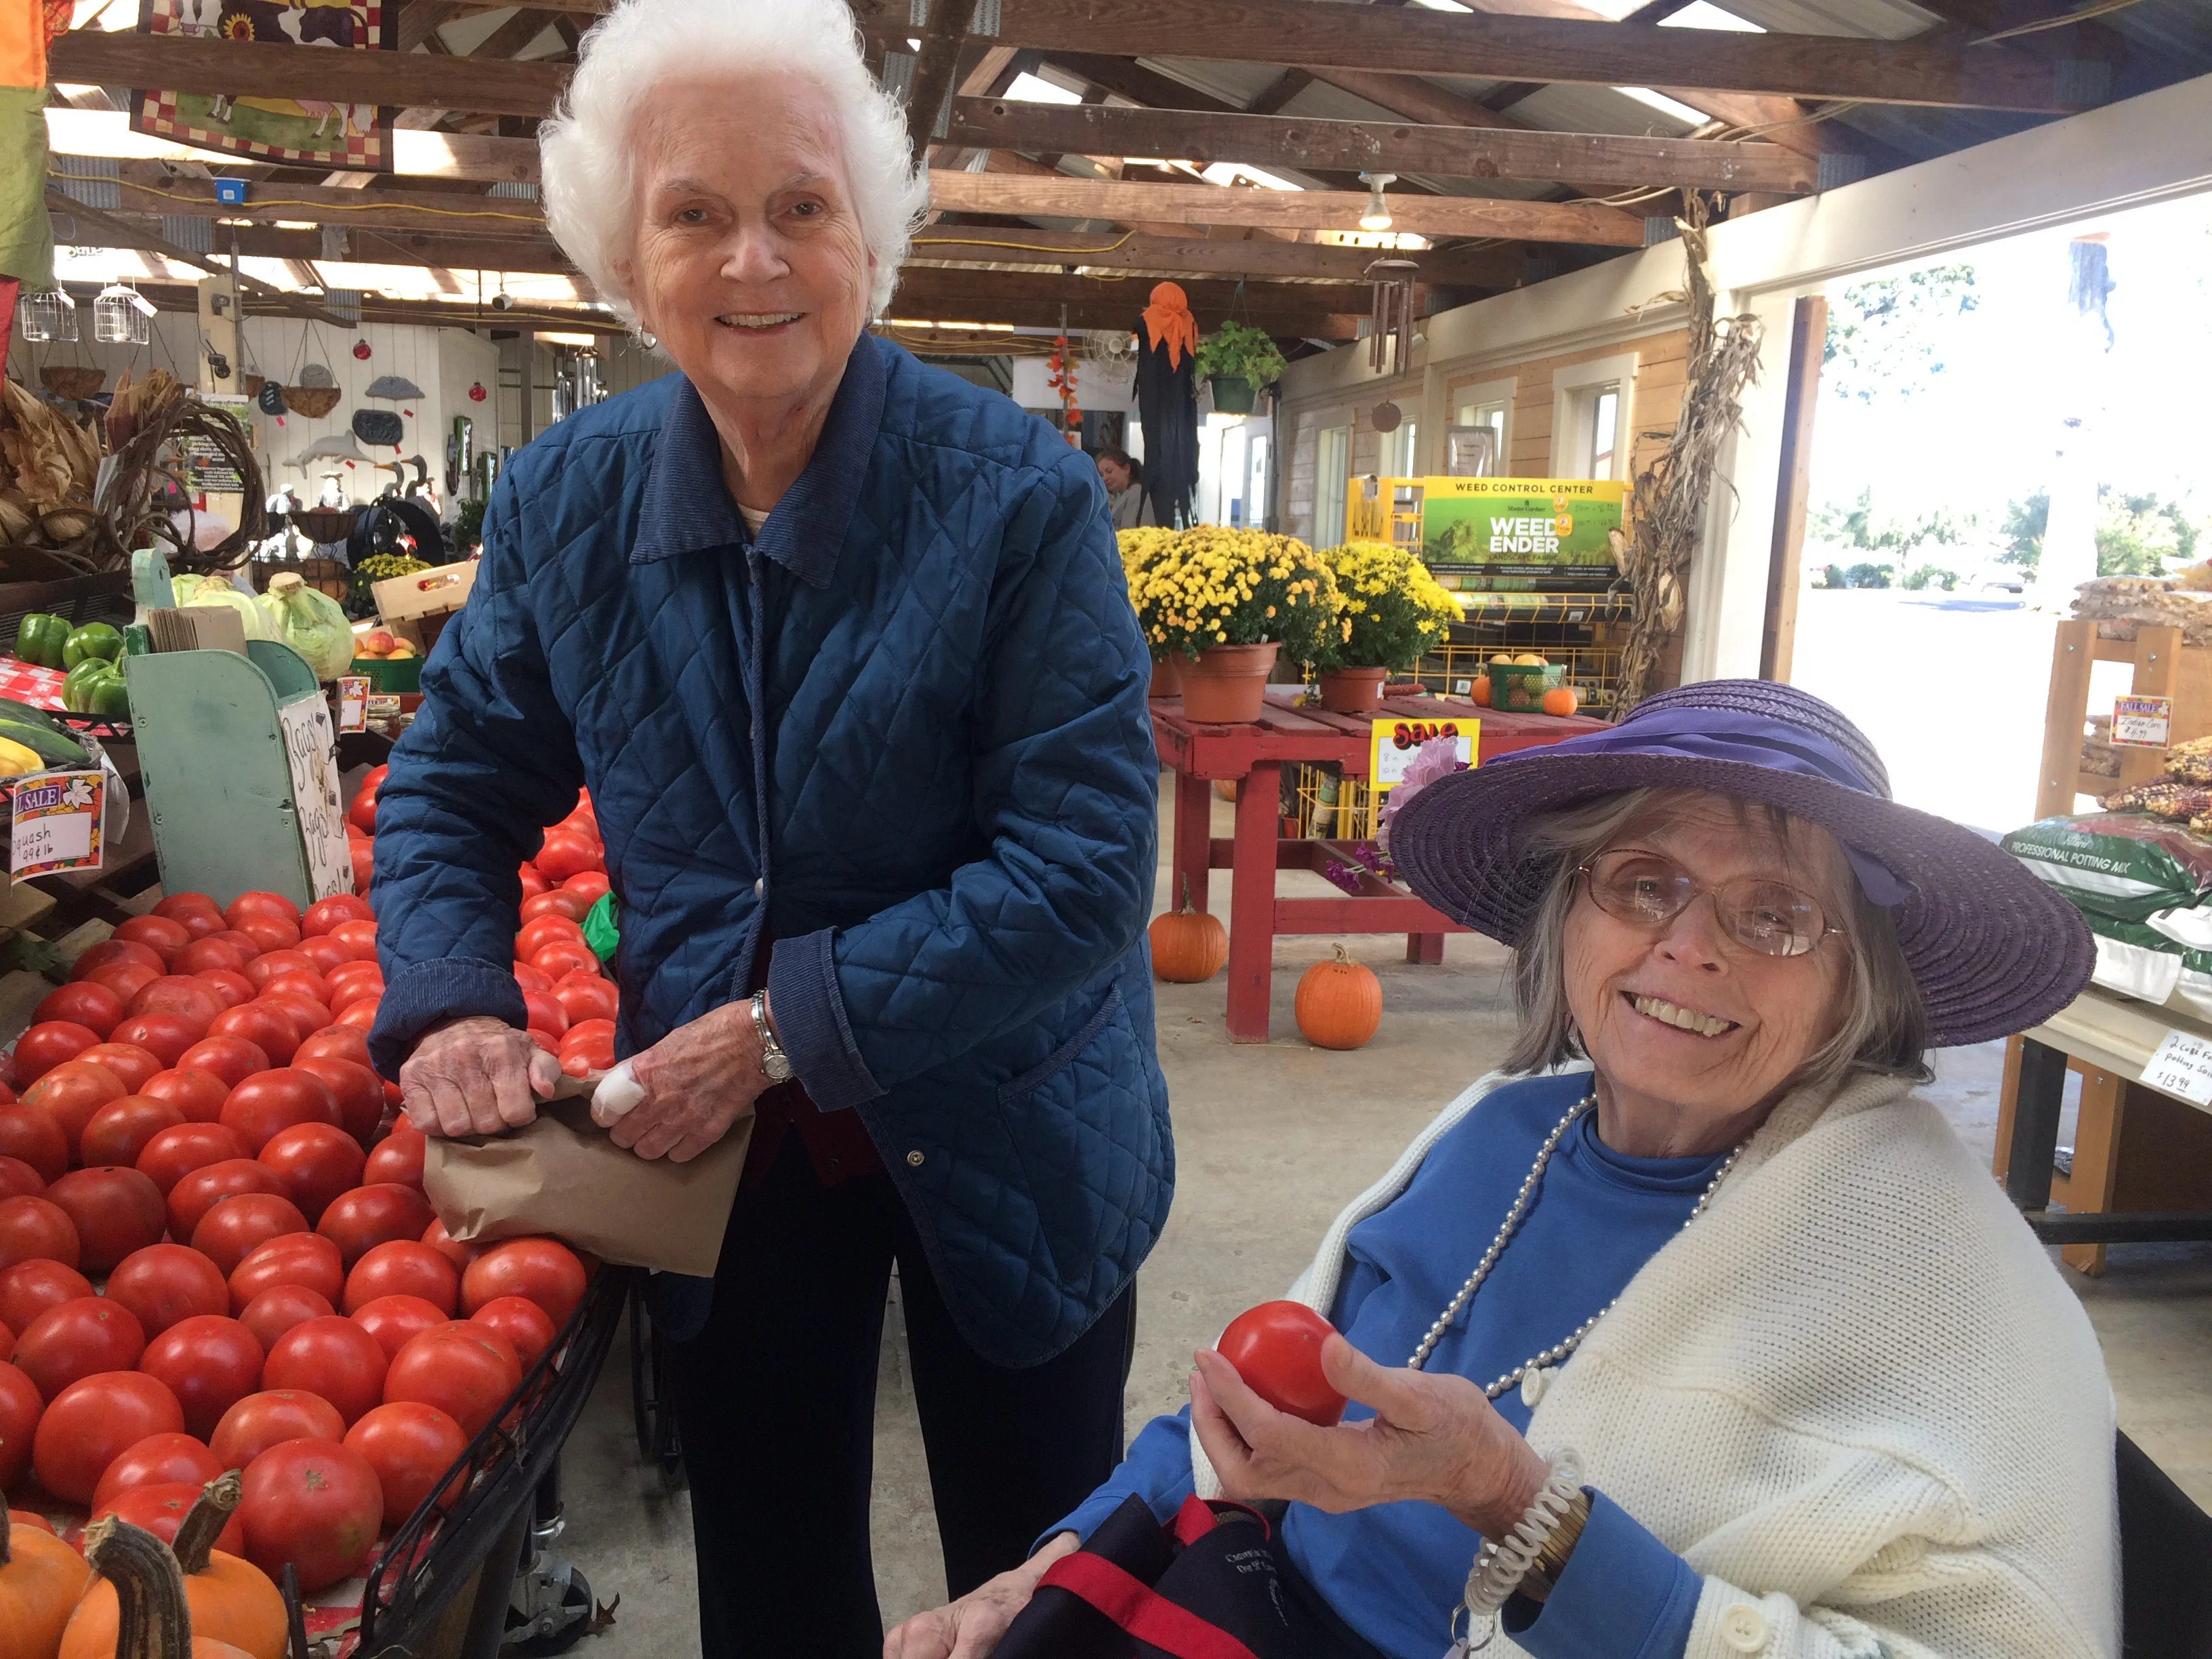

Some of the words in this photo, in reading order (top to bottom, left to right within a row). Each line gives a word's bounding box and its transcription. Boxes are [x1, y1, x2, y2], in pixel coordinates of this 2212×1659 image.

[1456, 483, 1488, 491] WEED
[1492, 484, 1545, 493] CONTROL
[1550, 485, 1593, 493] CENTER
[1490, 516, 1557, 536] WEED
[1490, 536, 1559, 553] ENDER
[2120, 702, 2139, 712] FALL
[2139, 703, 2157, 712] SALE
[2118, 717, 2145, 726] Indian
[2146, 719, 2162, 729] Corn
[1383, 753, 1389, 762] 8
[25, 789, 57, 811] SALE
[2011, 841, 2069, 862] PROFESSIONAL
[2070, 852, 2112, 870] POTTING
[2111, 861, 2132, 874] MIX
[2169, 1036, 2179, 1048] 2
